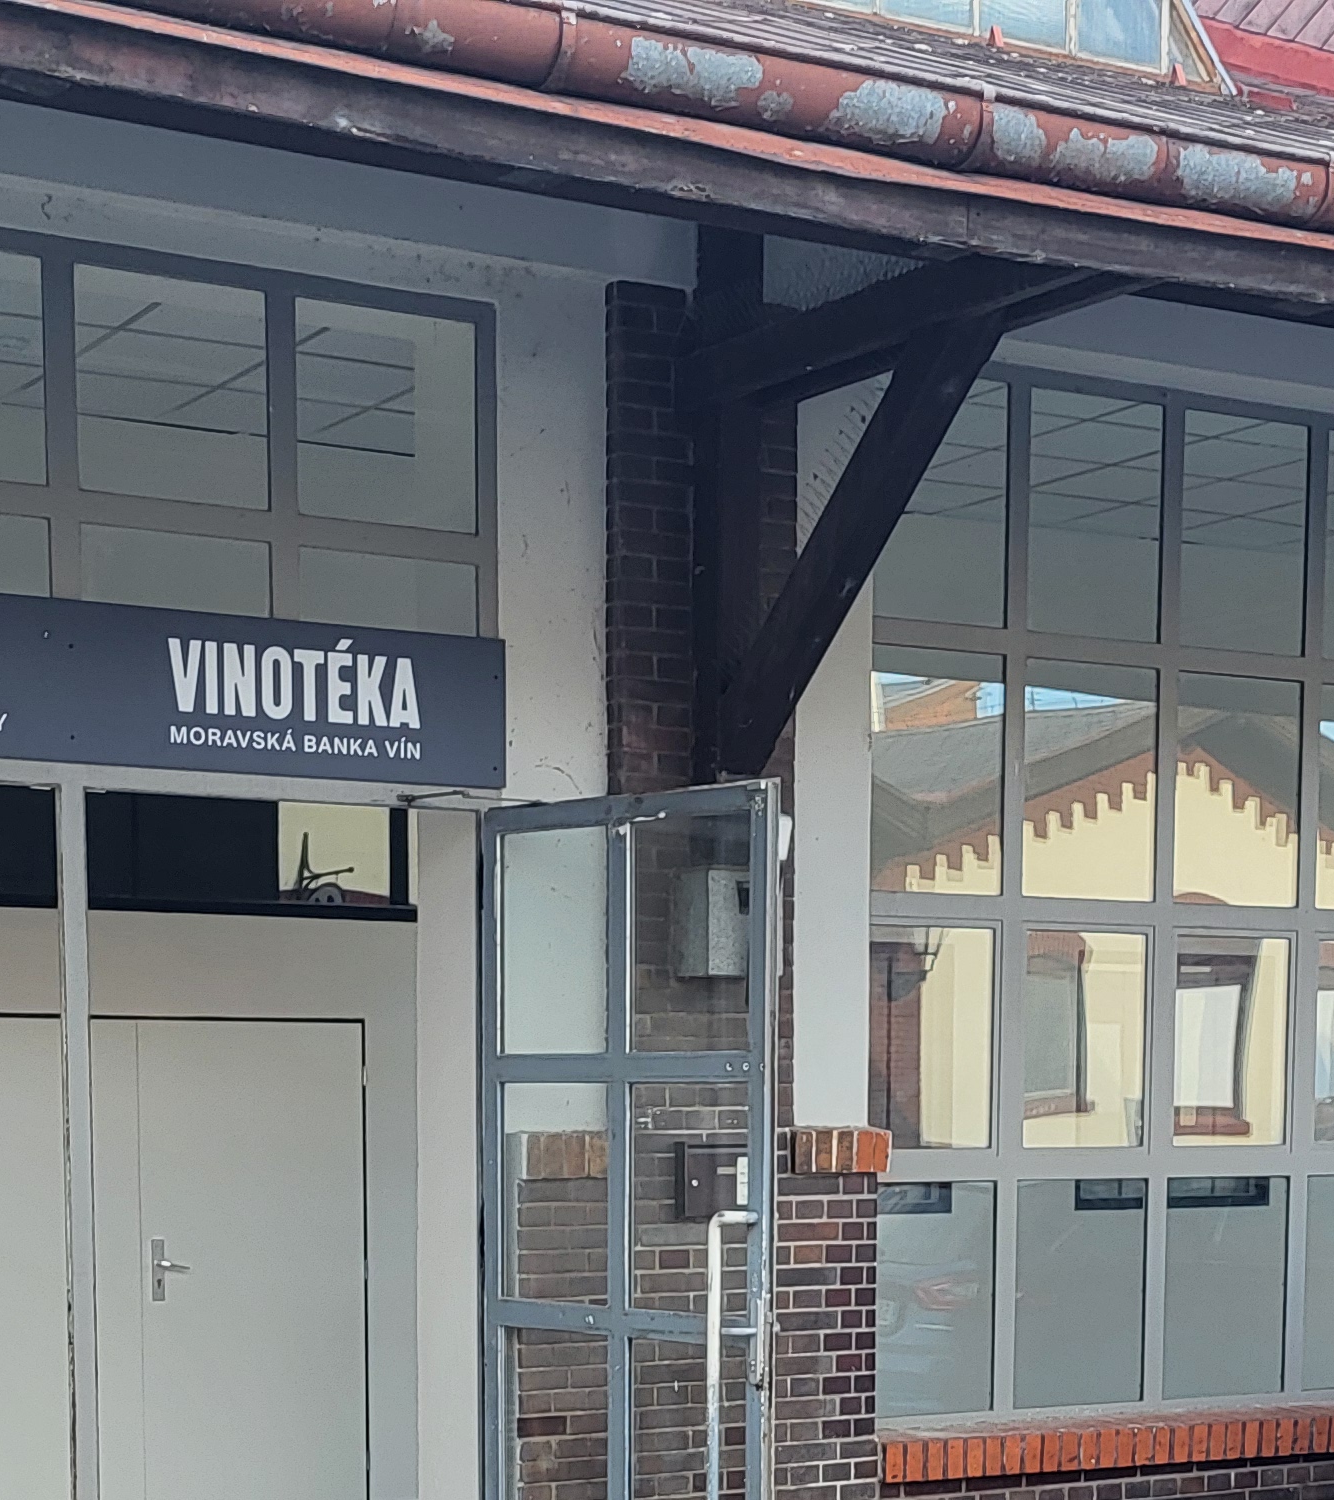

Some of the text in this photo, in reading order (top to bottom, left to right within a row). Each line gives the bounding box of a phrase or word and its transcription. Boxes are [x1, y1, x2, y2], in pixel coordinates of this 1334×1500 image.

[167, 637, 421, 729] VINOTÉKA
[169, 725, 422, 761] MORAVSKÁ BANKA VÍN
